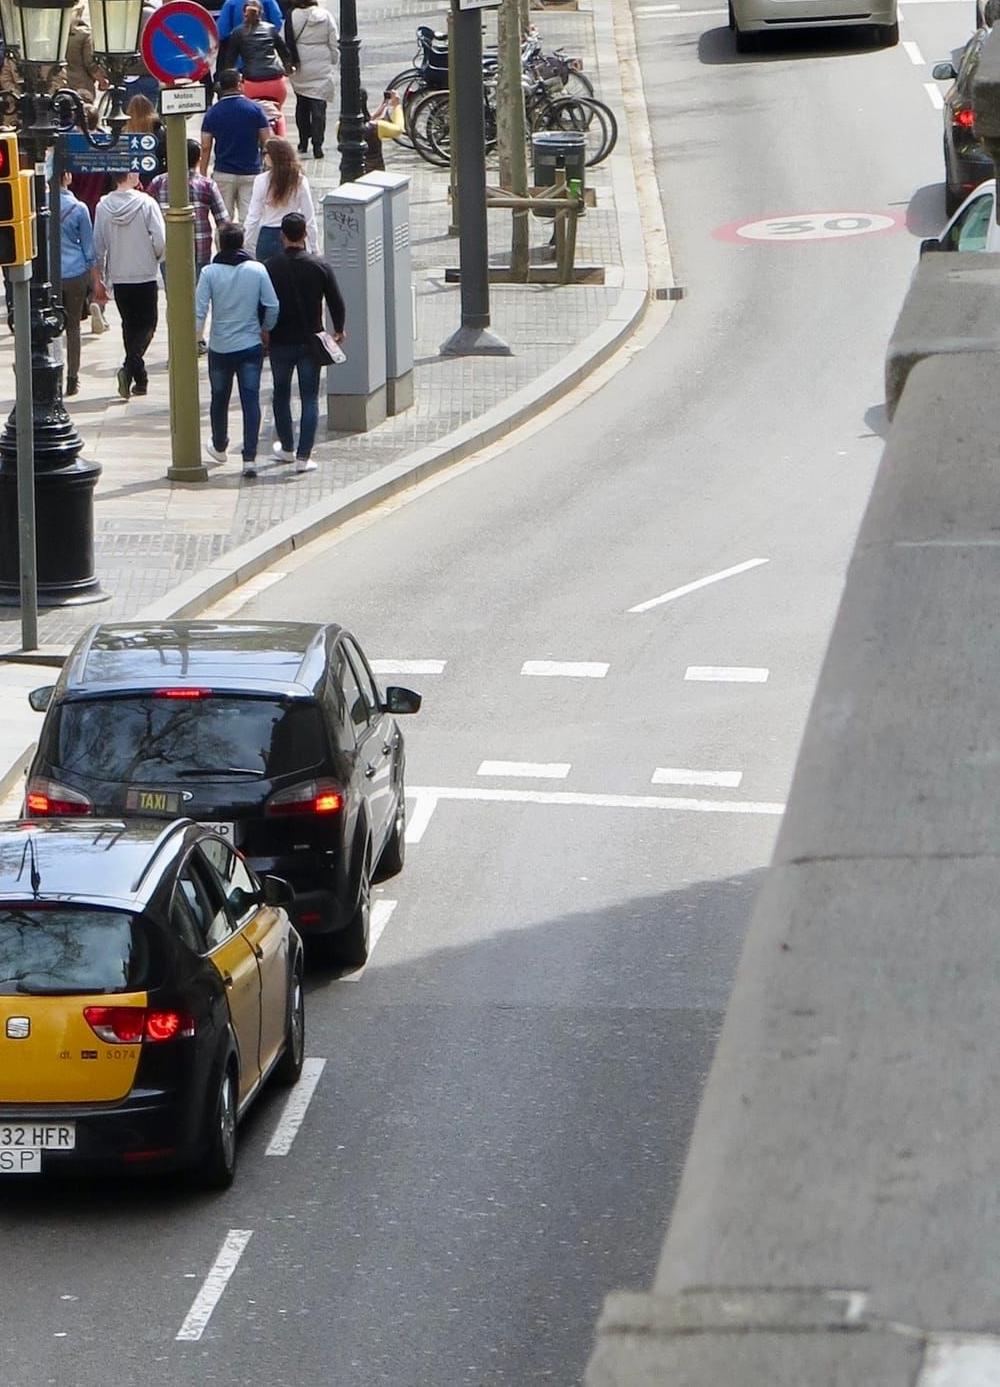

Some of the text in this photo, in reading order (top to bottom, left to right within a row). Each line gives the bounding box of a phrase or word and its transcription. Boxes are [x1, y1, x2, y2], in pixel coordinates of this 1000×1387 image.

[766, 217, 873, 235] 30
[140, 792, 166, 810] TAXI
[32, 1127, 70, 1146] HFR
[0, 1150, 35, 1170] SP
